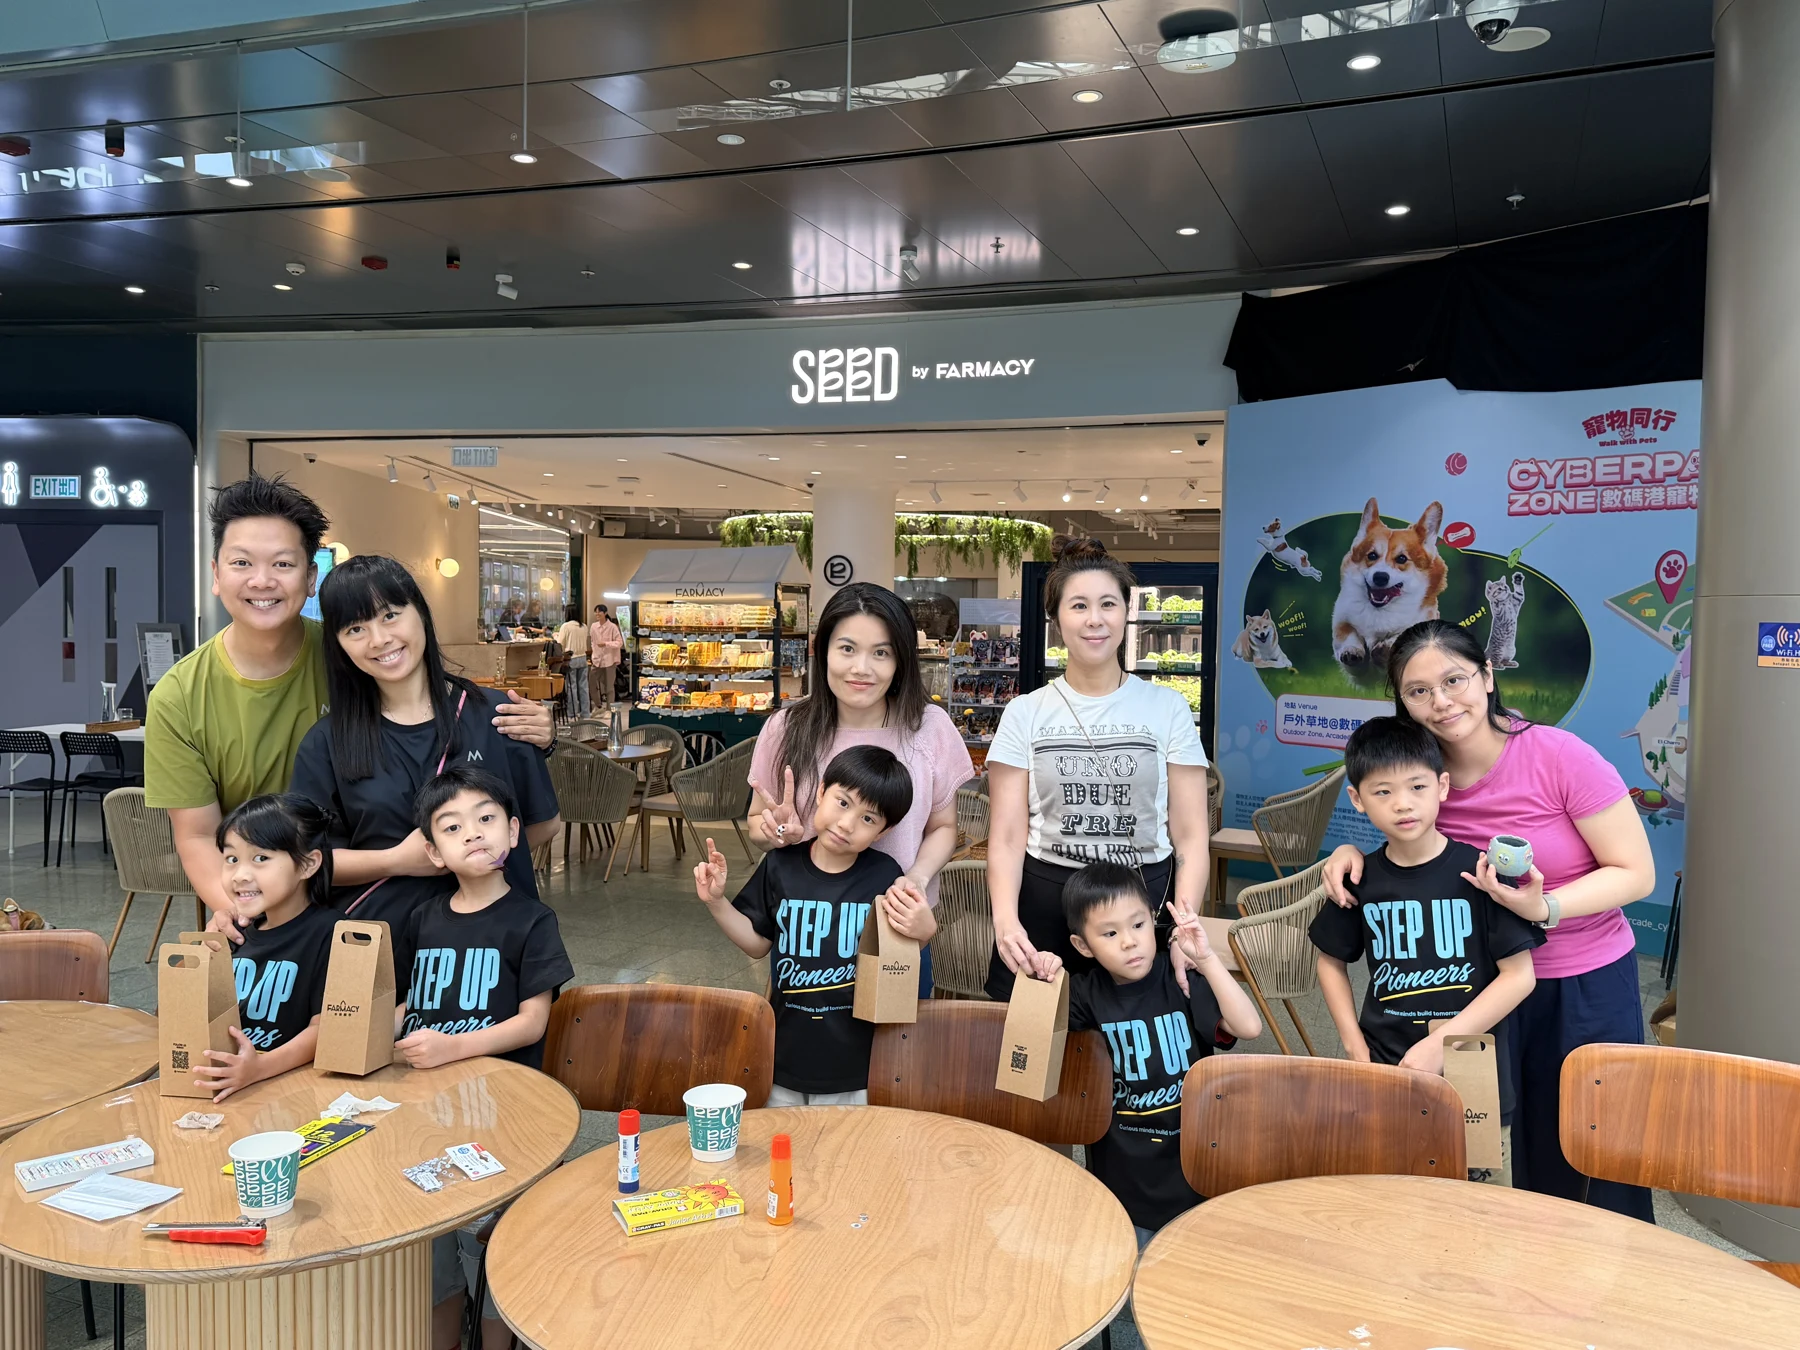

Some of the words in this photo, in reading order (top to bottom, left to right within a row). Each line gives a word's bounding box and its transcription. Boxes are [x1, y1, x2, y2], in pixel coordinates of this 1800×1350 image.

[791, 346, 899, 404] SEED
[912, 364, 929, 379] by
[935, 358, 1035, 379] FARMACY
[1581, 407, 1677, 439] 寵物同行
[1599, 439, 1618, 447] Walk
[1620, 438, 1638, 446] with
[1639, 437, 1657, 445] Pets
[1508, 489, 1598, 516] ZONE
[675, 583, 725, 598] FARMACY
[1038, 725, 1086, 737] MAX
[1089, 723, 1153, 736] MARA
[1283, 714, 1366, 731] 戶外草地@數碼
[1283, 728, 1306, 736] Outdoor
[1055, 754, 1138, 777] UNO
[1060, 783, 1131, 806] DUE
[1060, 813, 1137, 837] TRE
[776, 898, 832, 957] STEP
[837, 902, 872, 959] UP
[1363, 900, 1424, 960] STEP
[1431, 898, 1473, 959] UP
[777, 957, 856, 989] Pioneer
[882, 960, 911, 972] FARMACY
[247, 959, 299, 1023] UP
[406, 948, 456, 1010] STEP
[458, 948, 500, 1011] UP
[1373, 962, 1475, 997] Pioneers
[327, 999, 360, 1013] FARMACY
[1153, 1011, 1192, 1076] UP
[1112, 1078, 1183, 1109] Pioneer
[1119, 1123, 1138, 1132] Curious
[1139, 1126, 1154, 1134] minds
[1155, 1128, 1168, 1136] build
[636, 1221, 665, 1231] CRAY-PAS
[666, 1216, 691, 1226] Junior
[693, 1212, 713, 1221] Artist
